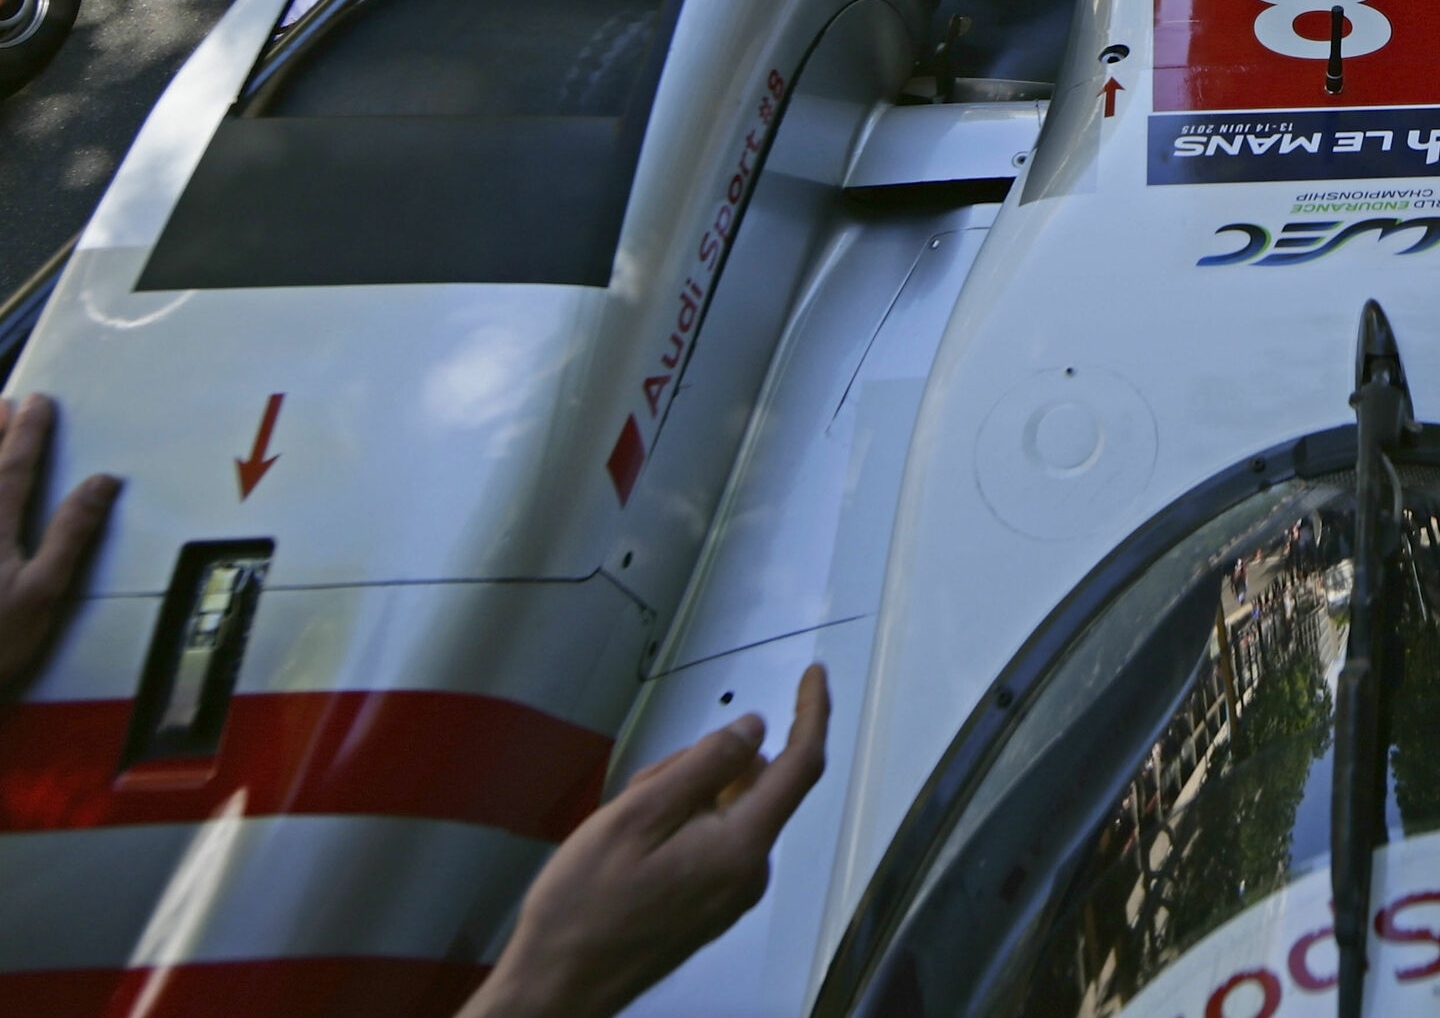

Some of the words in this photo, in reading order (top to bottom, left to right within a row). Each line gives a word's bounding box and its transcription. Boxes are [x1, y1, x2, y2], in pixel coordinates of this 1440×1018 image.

[1181, 124, 1215, 135] 2015
[1218, 122, 1255, 134] JUIN
[1173, 131, 1322, 158] MANS
[1332, 129, 1393, 153] LE
[1296, 188, 1434, 202] CHAMPIONSHIP
[1290, 200, 1410, 214] ENDURANCE
[642, 277, 704, 420] Audi
[699, 128, 761, 272] Sport
[757, 68, 785, 127] #8
